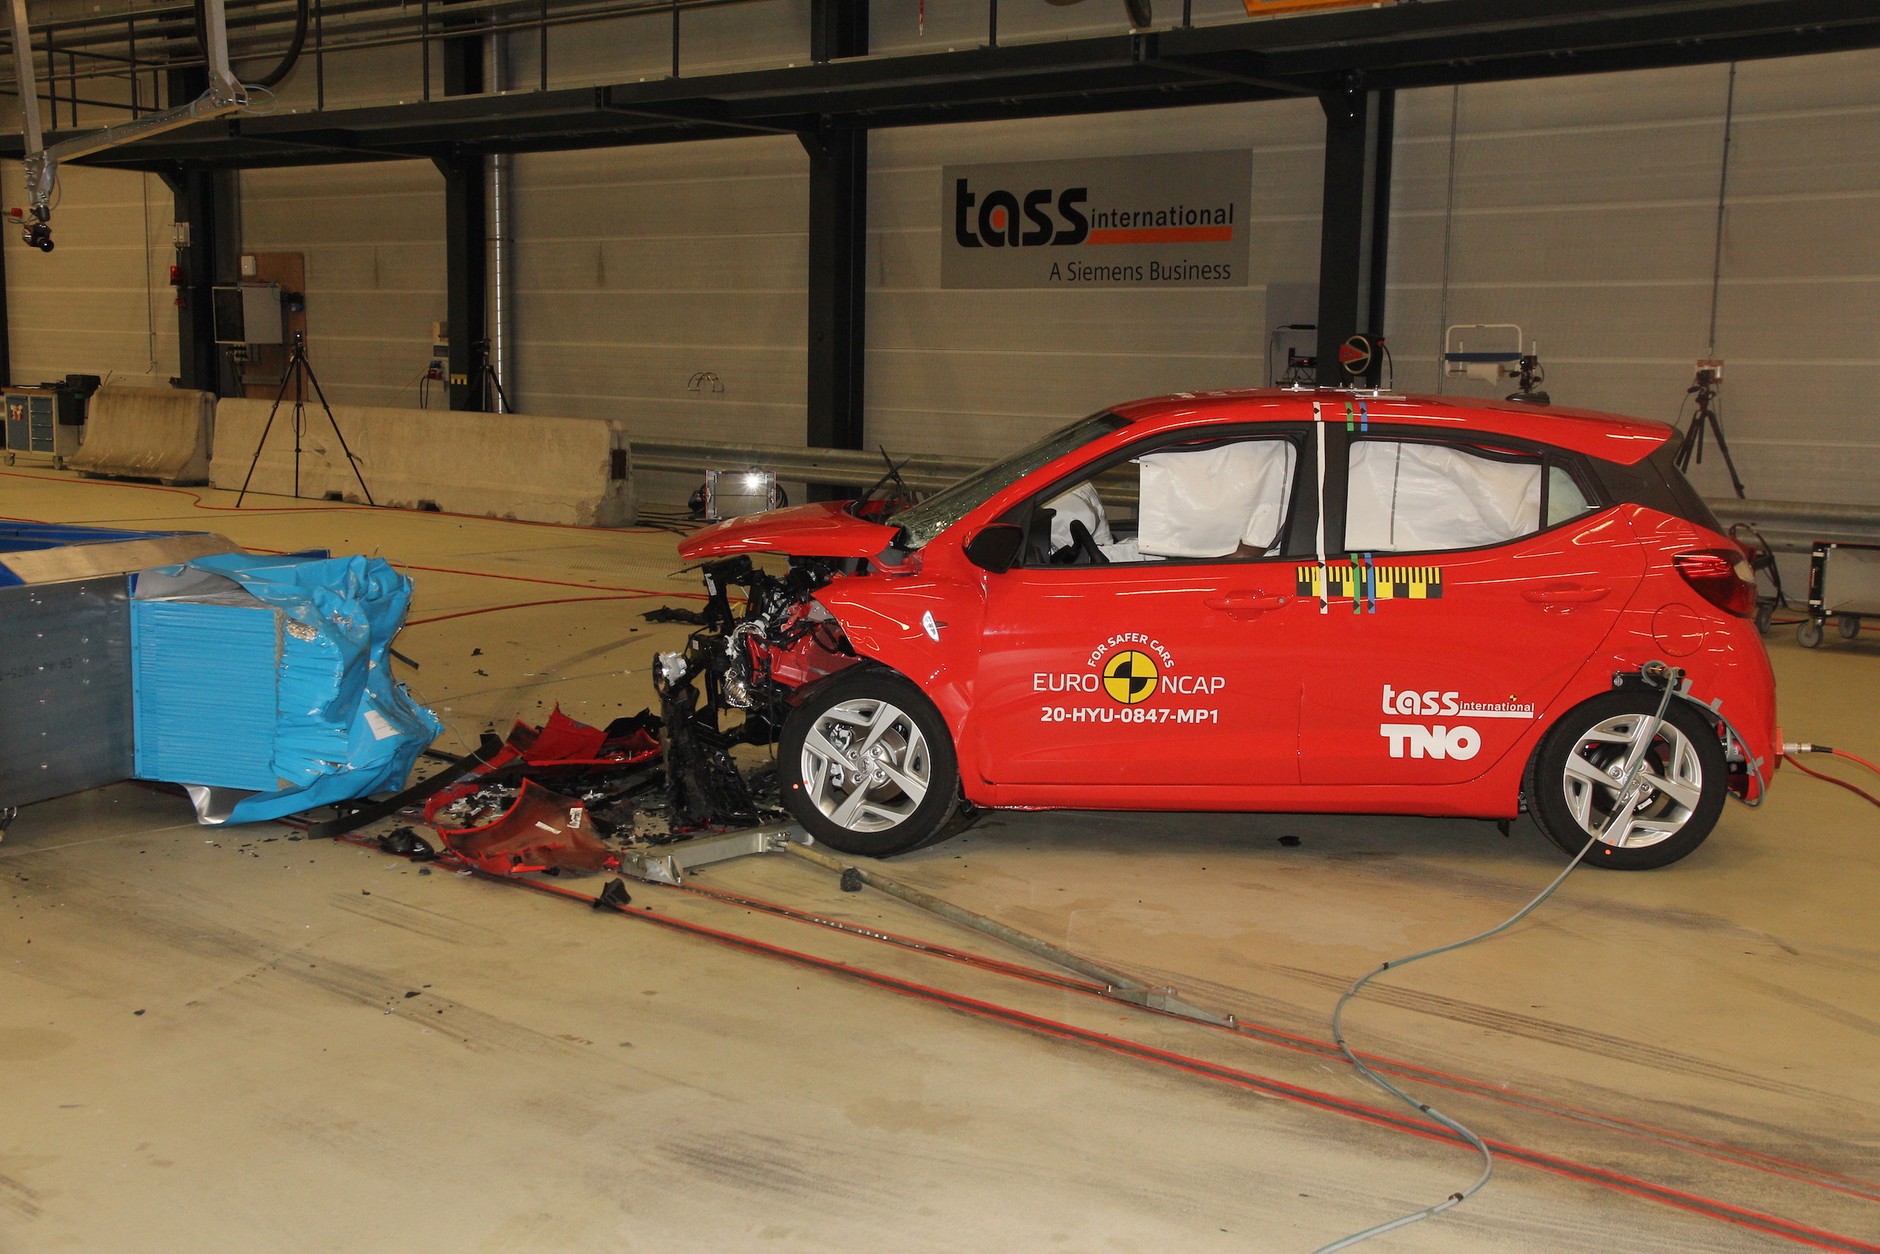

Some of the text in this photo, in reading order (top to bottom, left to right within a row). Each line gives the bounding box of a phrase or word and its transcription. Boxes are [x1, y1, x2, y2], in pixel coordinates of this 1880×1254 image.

[956, 178, 1234, 247] tass international
[1050, 259, 1231, 281] A Siemens Business
[1087, 632, 1175, 669] FOR SAFER CARS
[1033, 673, 1226, 695] EURO NCAP
[1382, 684, 1535, 716] tass international
[1040, 706, 1218, 724] 20-HYU-0847-MP1
[1380, 723, 1482, 761] TNO
